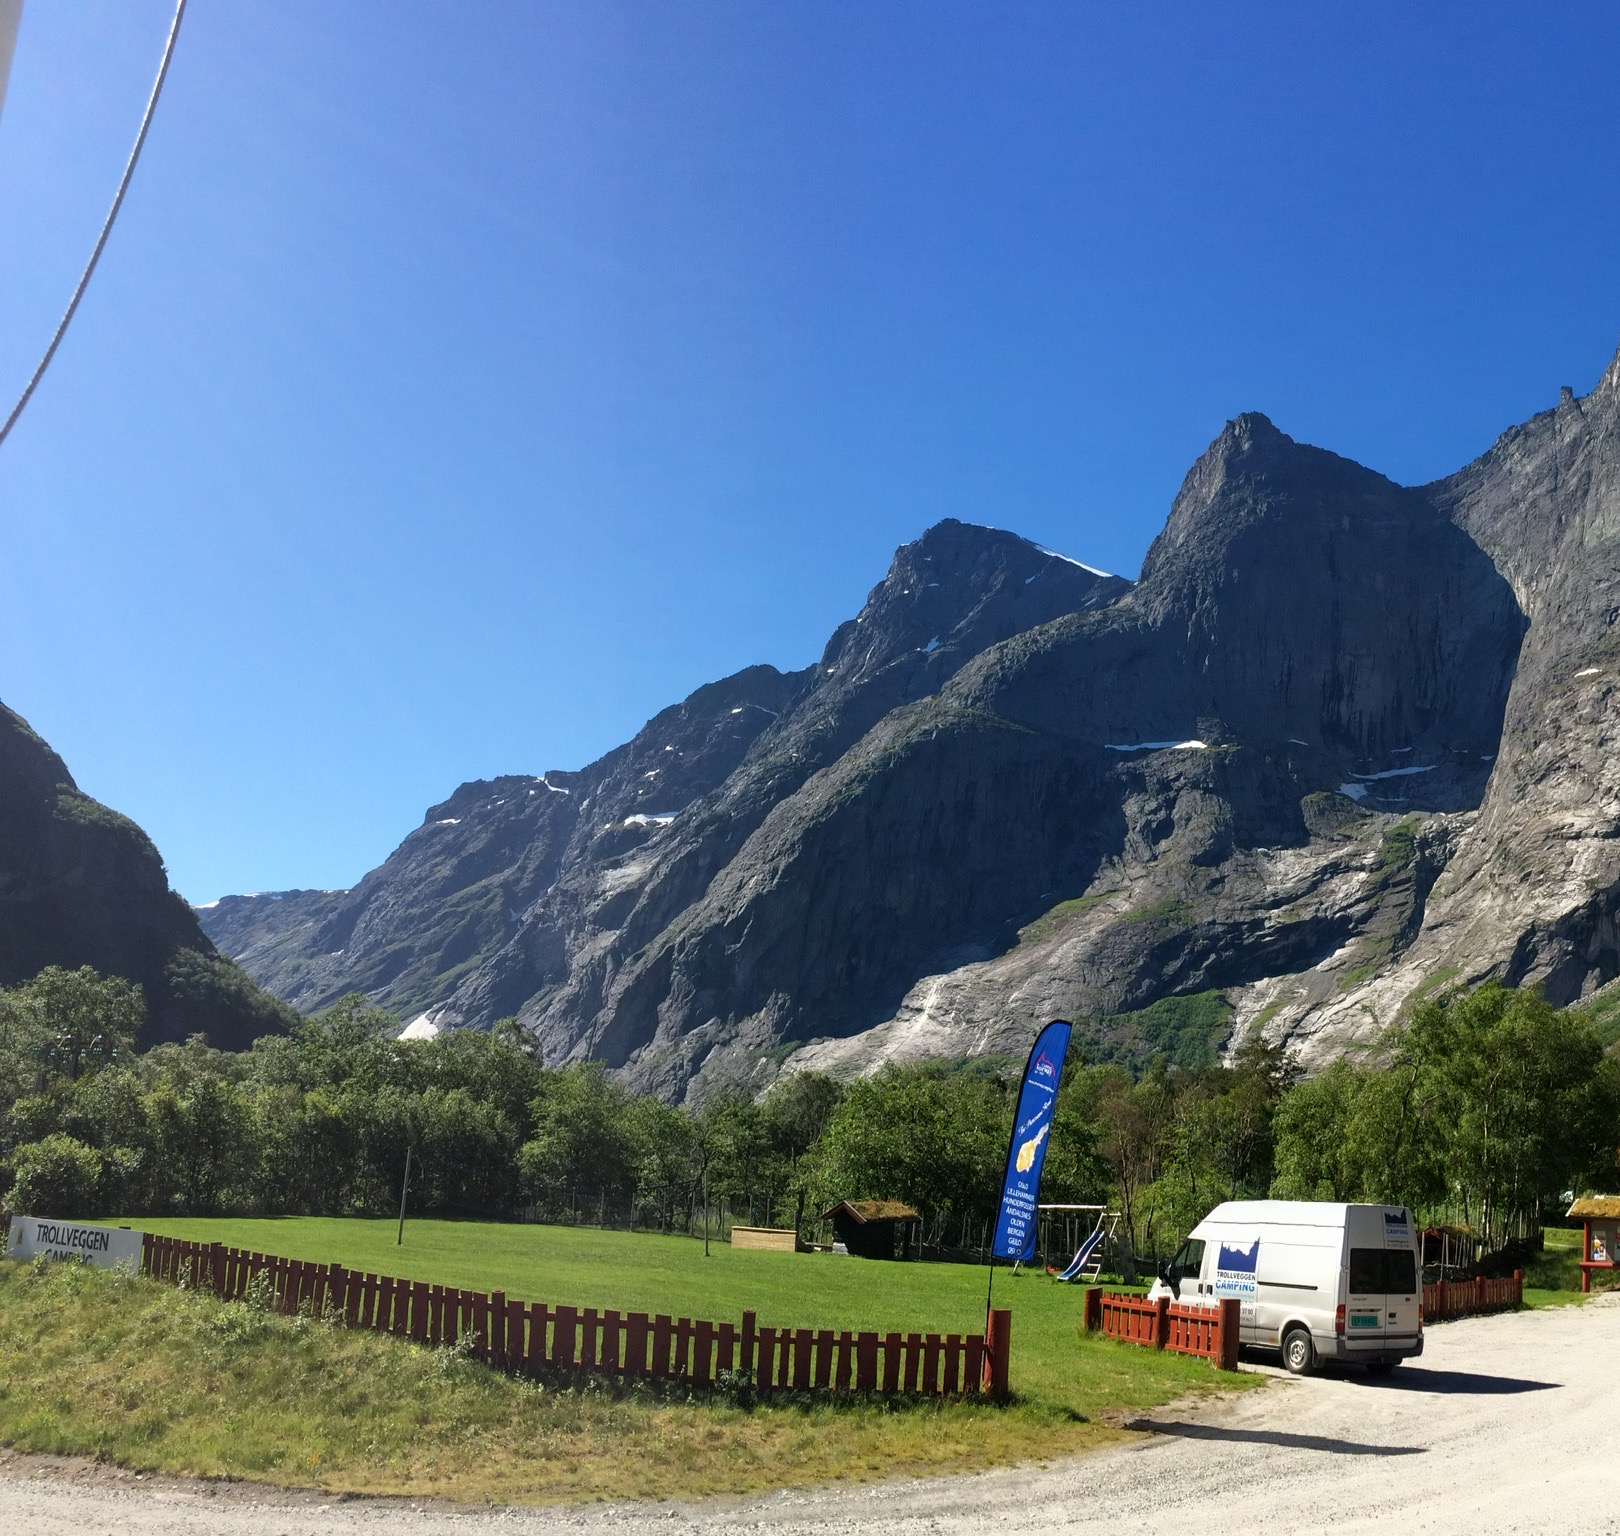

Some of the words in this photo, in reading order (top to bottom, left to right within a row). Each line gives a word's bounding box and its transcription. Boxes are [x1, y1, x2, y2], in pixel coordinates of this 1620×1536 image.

[1017, 1181, 1029, 1190] OSLO
[1006, 1187, 1035, 1202] LILLEHAMMER
[1010, 1218, 1025, 1228] OLDEN
[37, 1224, 109, 1251] TROLLVEGGEN
[1007, 1227, 1025, 1238] BERGEN
[1217, 1271, 1256, 1280] TROLLVEGGEN
[1215, 1280, 1255, 1292] CAMPING
